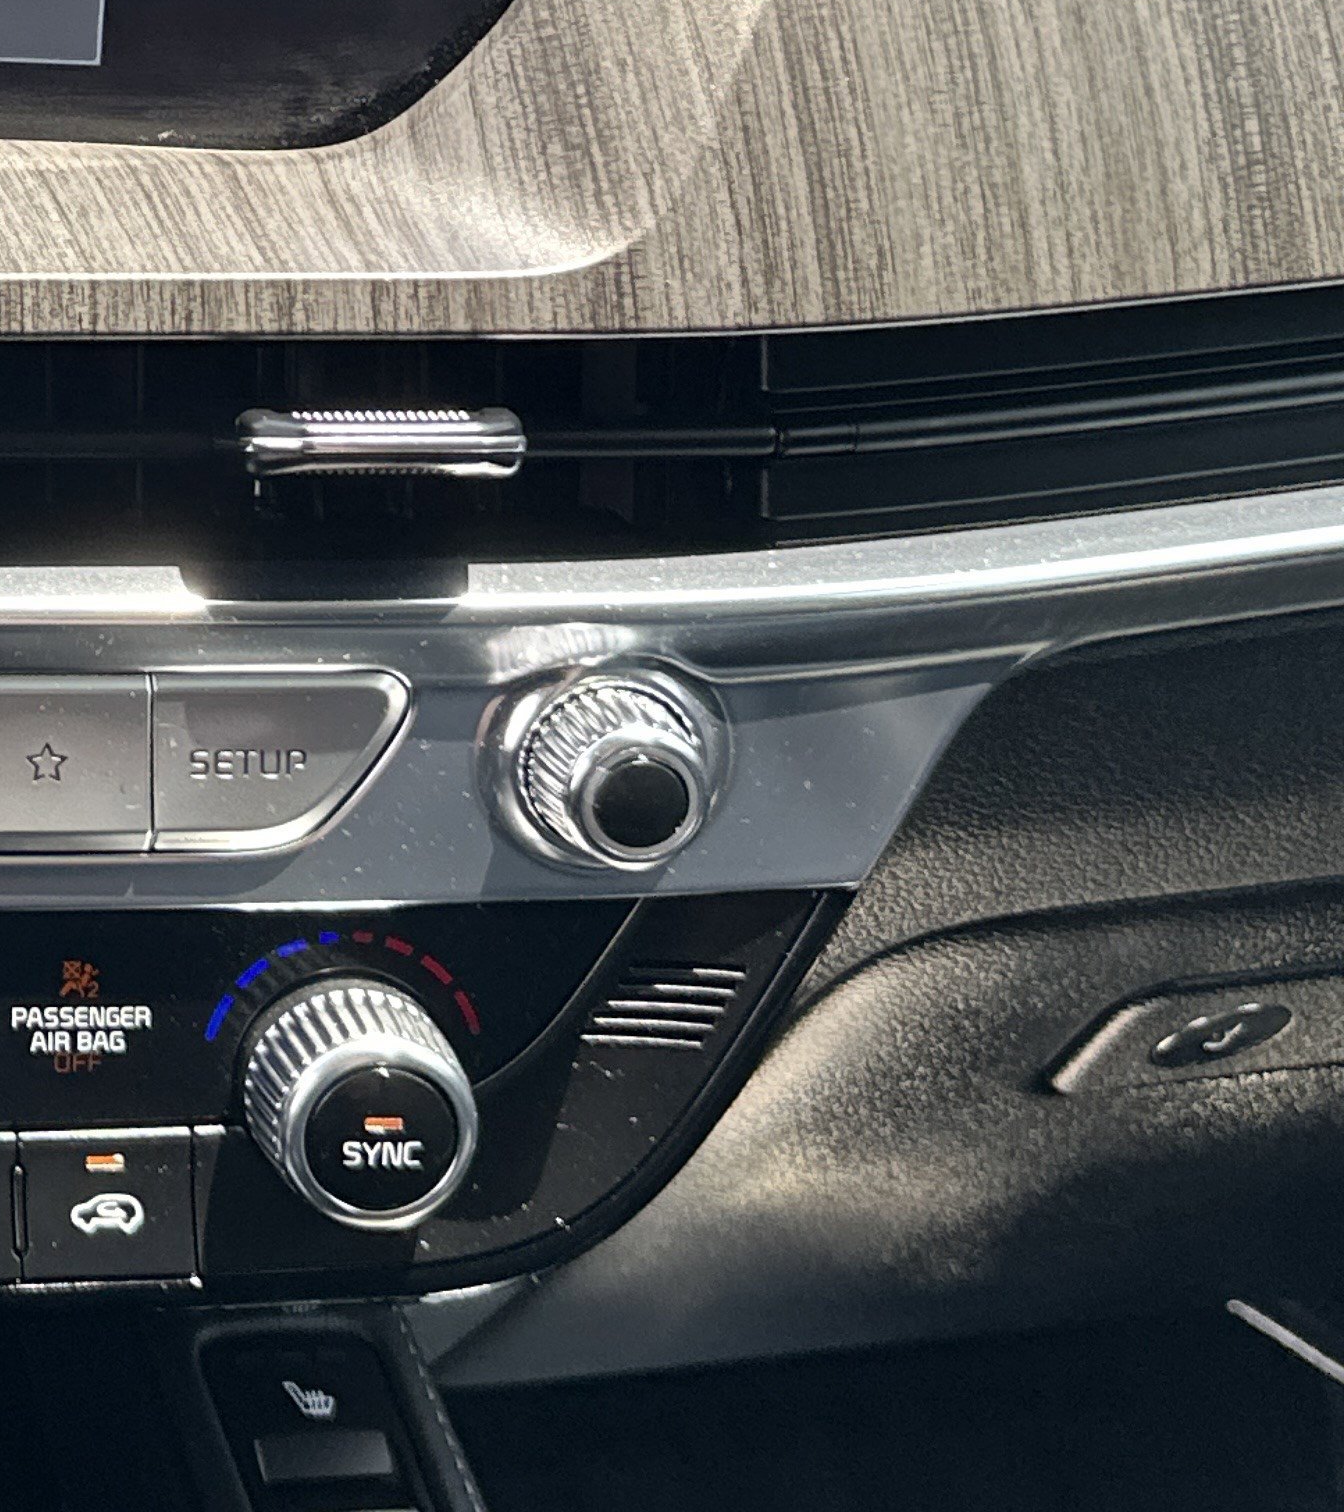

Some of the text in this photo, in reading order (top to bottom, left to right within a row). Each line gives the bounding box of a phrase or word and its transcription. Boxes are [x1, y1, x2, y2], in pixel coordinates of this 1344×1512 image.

[189, 749, 306, 779] SETUP
[12, 1006, 151, 1030] PASSENGER
[31, 1031, 125, 1054] AIR BAG
[54, 1053, 101, 1074] OFF
[342, 1141, 422, 1168] SYNC
